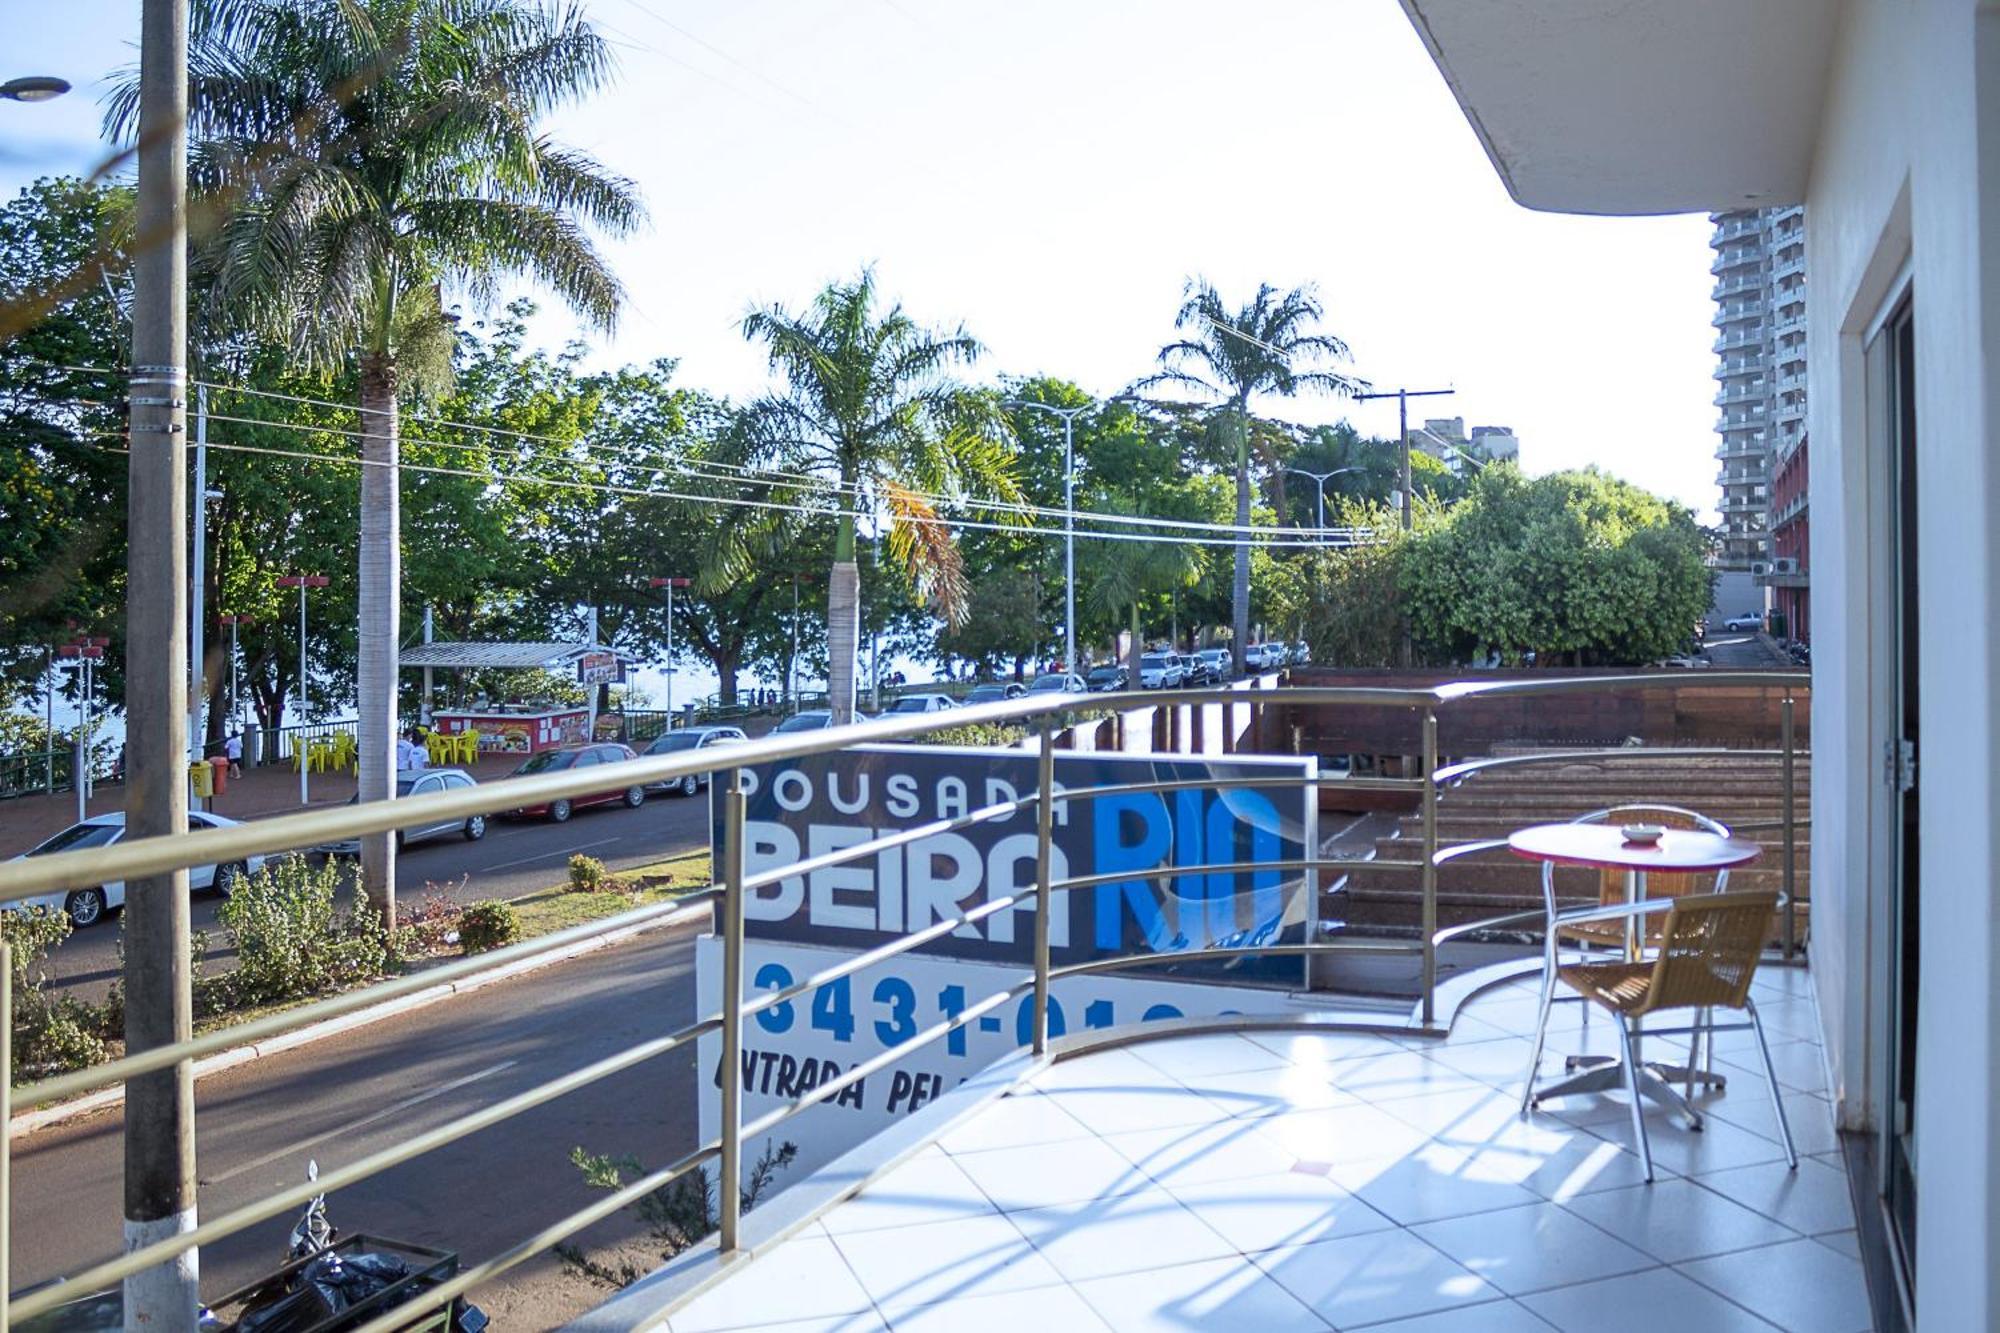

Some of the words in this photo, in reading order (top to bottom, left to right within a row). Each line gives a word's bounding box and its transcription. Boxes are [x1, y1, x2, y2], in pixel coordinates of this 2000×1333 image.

[740, 768, 1068, 826] POUSADA
[743, 820, 1069, 948] BEIRA
[714, 1049, 866, 1110] NTRADA
